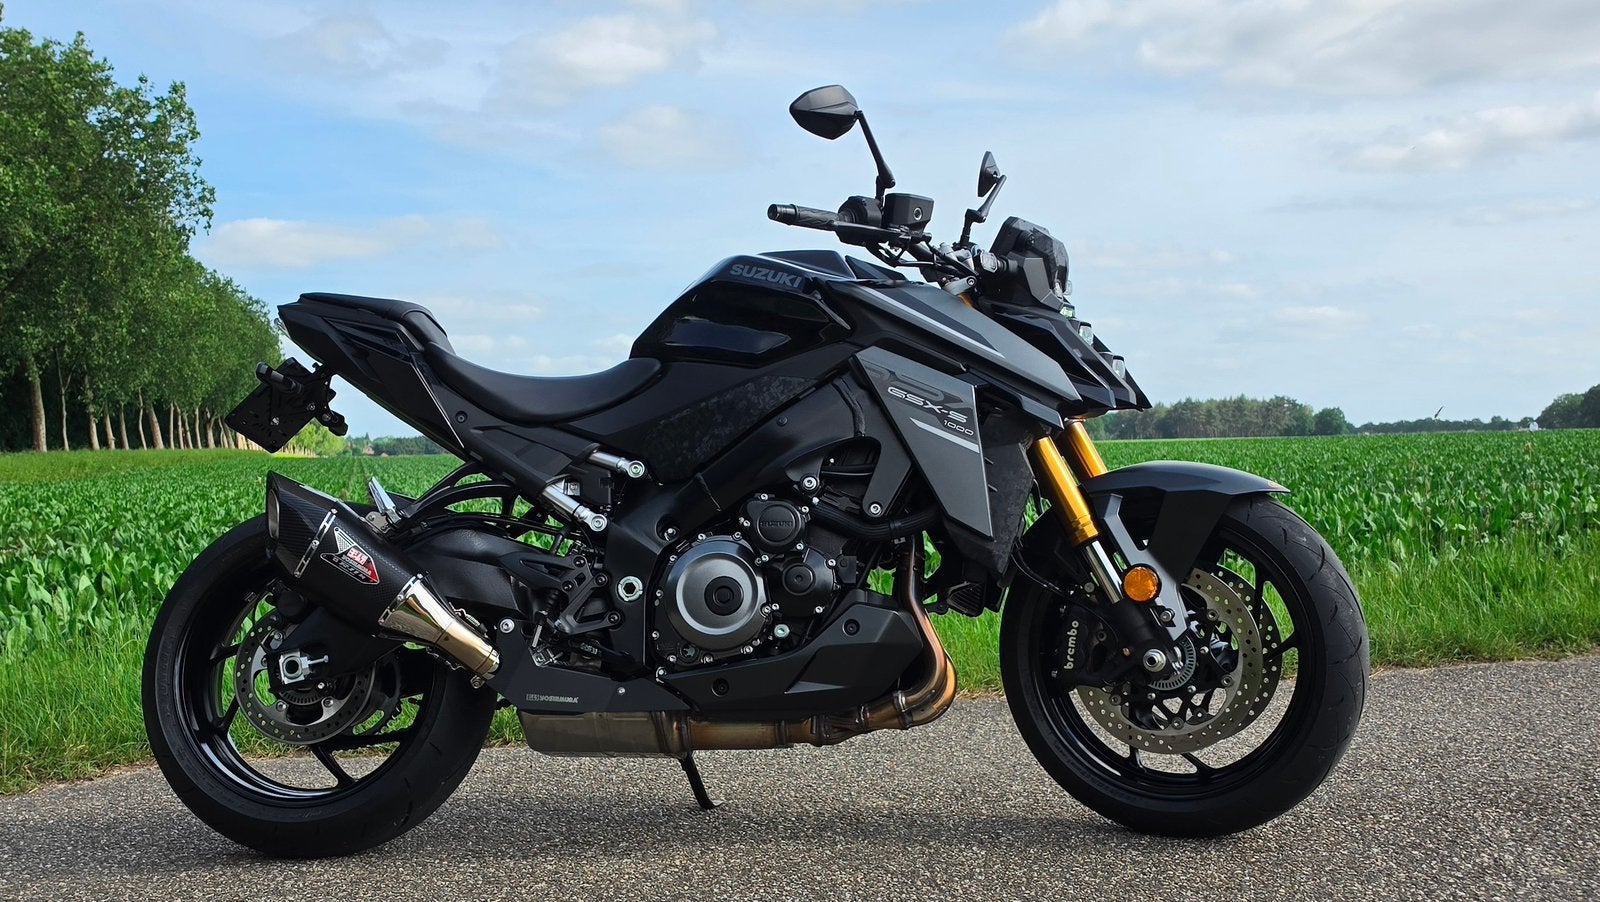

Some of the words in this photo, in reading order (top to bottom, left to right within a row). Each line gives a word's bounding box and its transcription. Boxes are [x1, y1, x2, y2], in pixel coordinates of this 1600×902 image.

[729, 264, 802, 288] SUZUKI
[887, 386, 968, 423] GSX-S
[943, 419, 974, 436] 1000
[760, 520, 793, 528] SUZUKI
